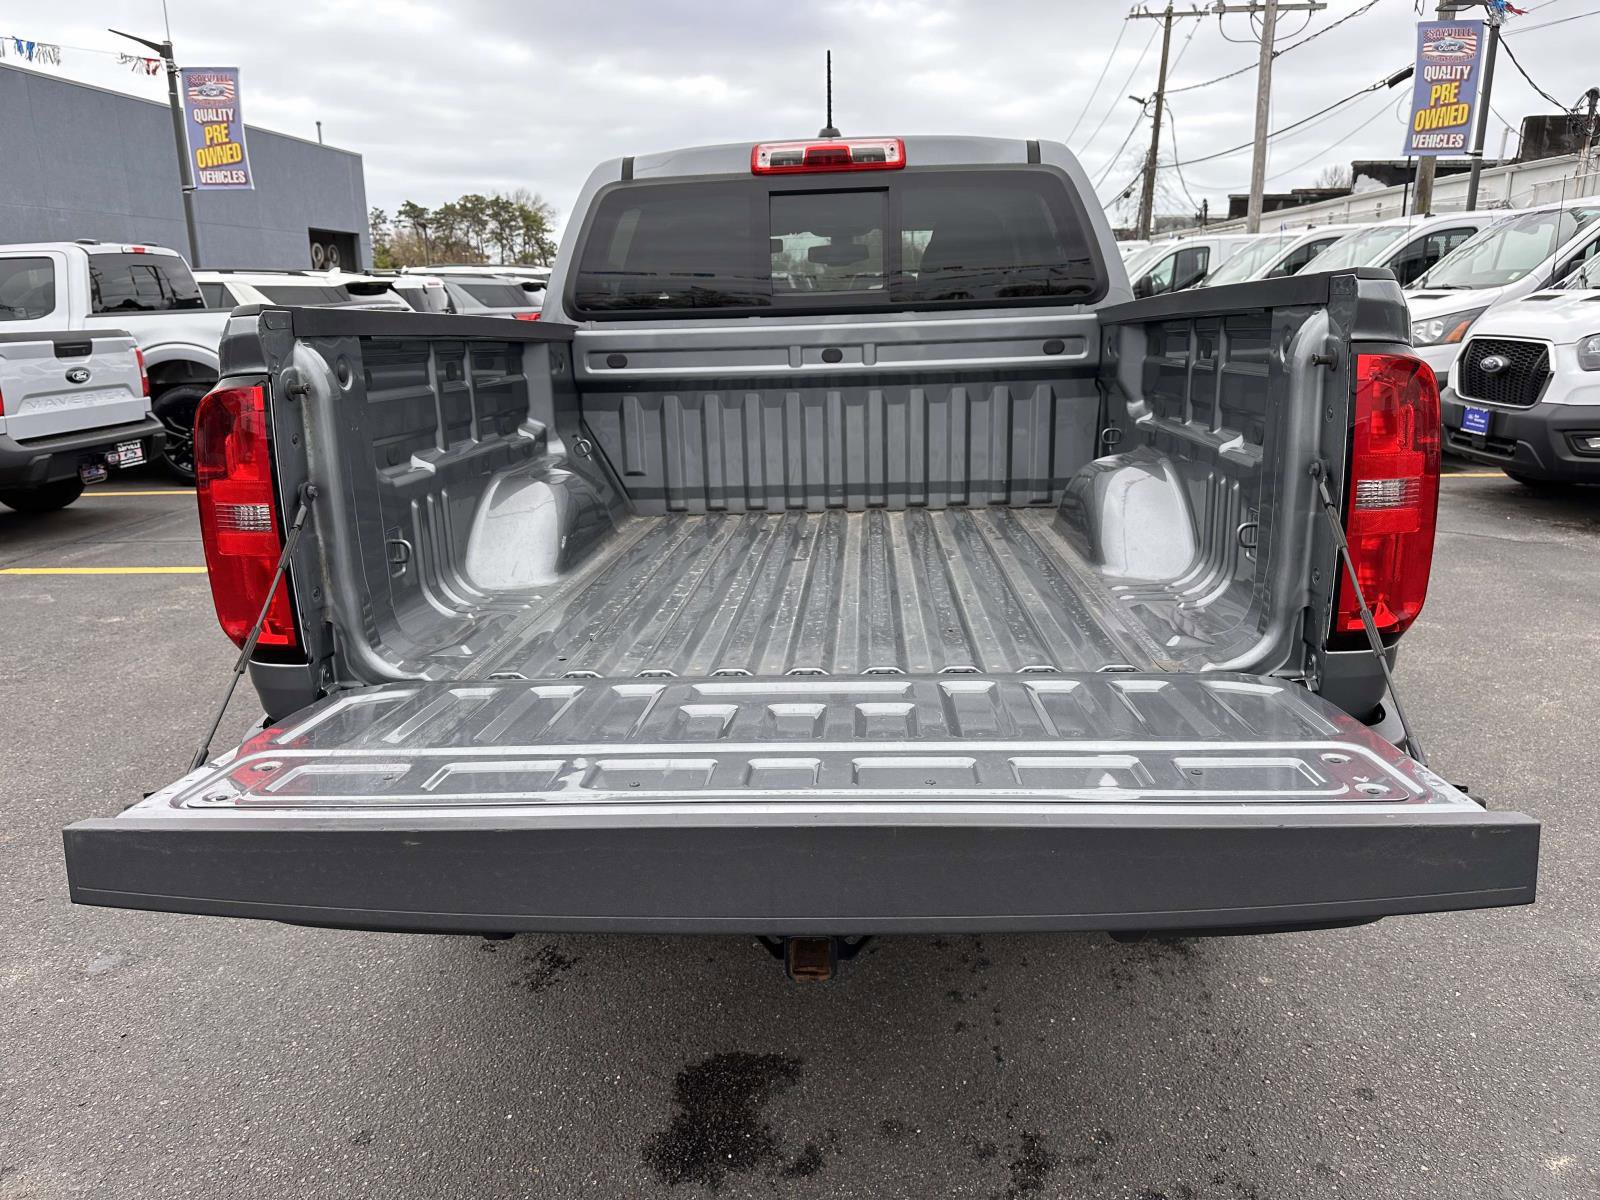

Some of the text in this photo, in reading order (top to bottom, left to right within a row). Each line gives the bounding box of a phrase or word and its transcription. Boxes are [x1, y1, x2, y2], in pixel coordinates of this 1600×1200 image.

[1438, 41, 1460, 51] Ford
[1424, 65, 1471, 81] QUALITY
[1429, 81, 1460, 106] PRE
[193, 108, 234, 123] QUALITY
[1414, 103, 1469, 131] OWNED
[204, 123, 230, 146] PRE
[1411, 134, 1464, 149] VEHICLES
[196, 142, 242, 168] OWNED
[200, 170, 246, 184] VEHICLES
